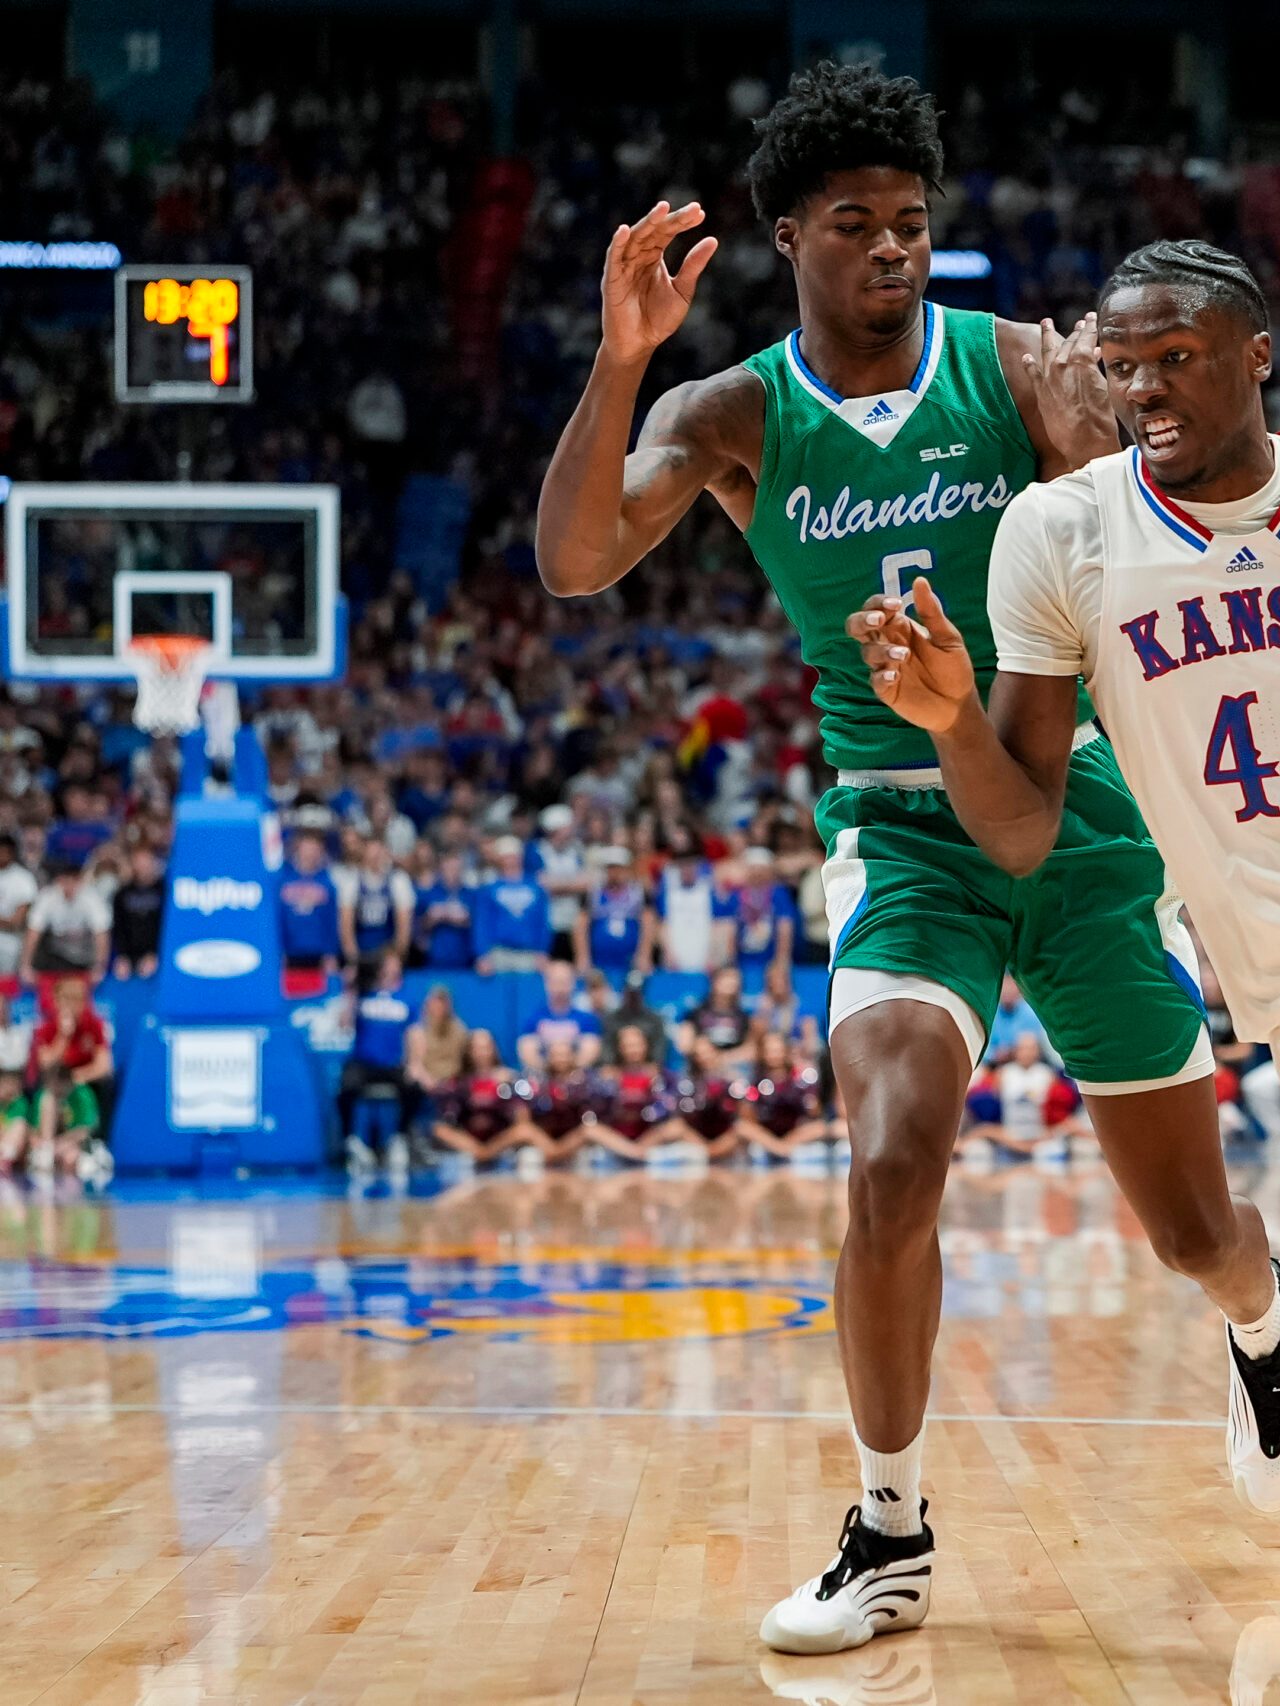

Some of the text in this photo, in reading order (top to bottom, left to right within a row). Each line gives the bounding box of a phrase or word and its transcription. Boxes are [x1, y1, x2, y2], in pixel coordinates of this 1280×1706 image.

[863, 412, 899, 425] adidas
[919, 443, 969, 462] SLC
[785, 471, 1013, 544] Islanders
[1226, 560, 1264, 573] adidas
